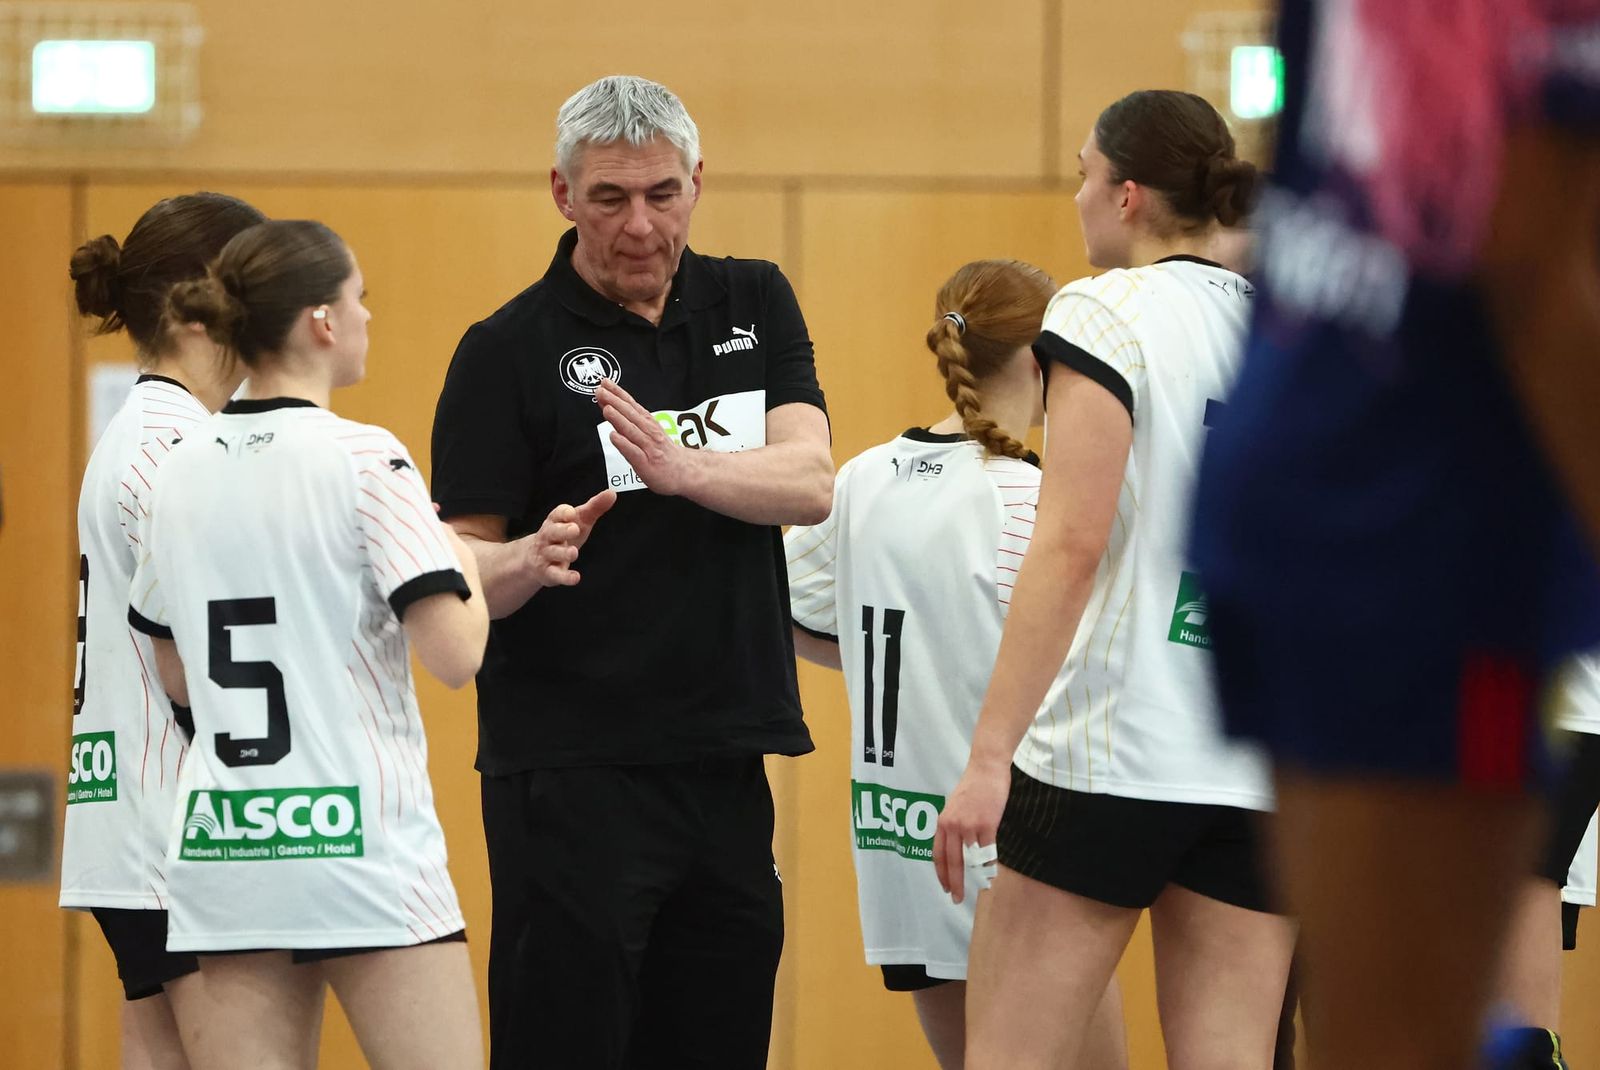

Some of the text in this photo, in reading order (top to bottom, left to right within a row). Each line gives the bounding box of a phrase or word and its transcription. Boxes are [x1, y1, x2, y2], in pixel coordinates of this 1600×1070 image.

[713, 337, 754, 356] PUMA
[610, 468, 645, 487] erle
[1179, 629, 1210, 645] Hand
[207, 597, 291, 768] 5
[862, 605, 906, 767] 11
[68, 740, 113, 785] SCO
[185, 791, 355, 840] ALSCO
[229, 846, 271, 857] Industrie
[277, 844, 315, 855] Gastro
[324, 842, 356, 854] Hotel
[911, 845, 933, 857] Hote
